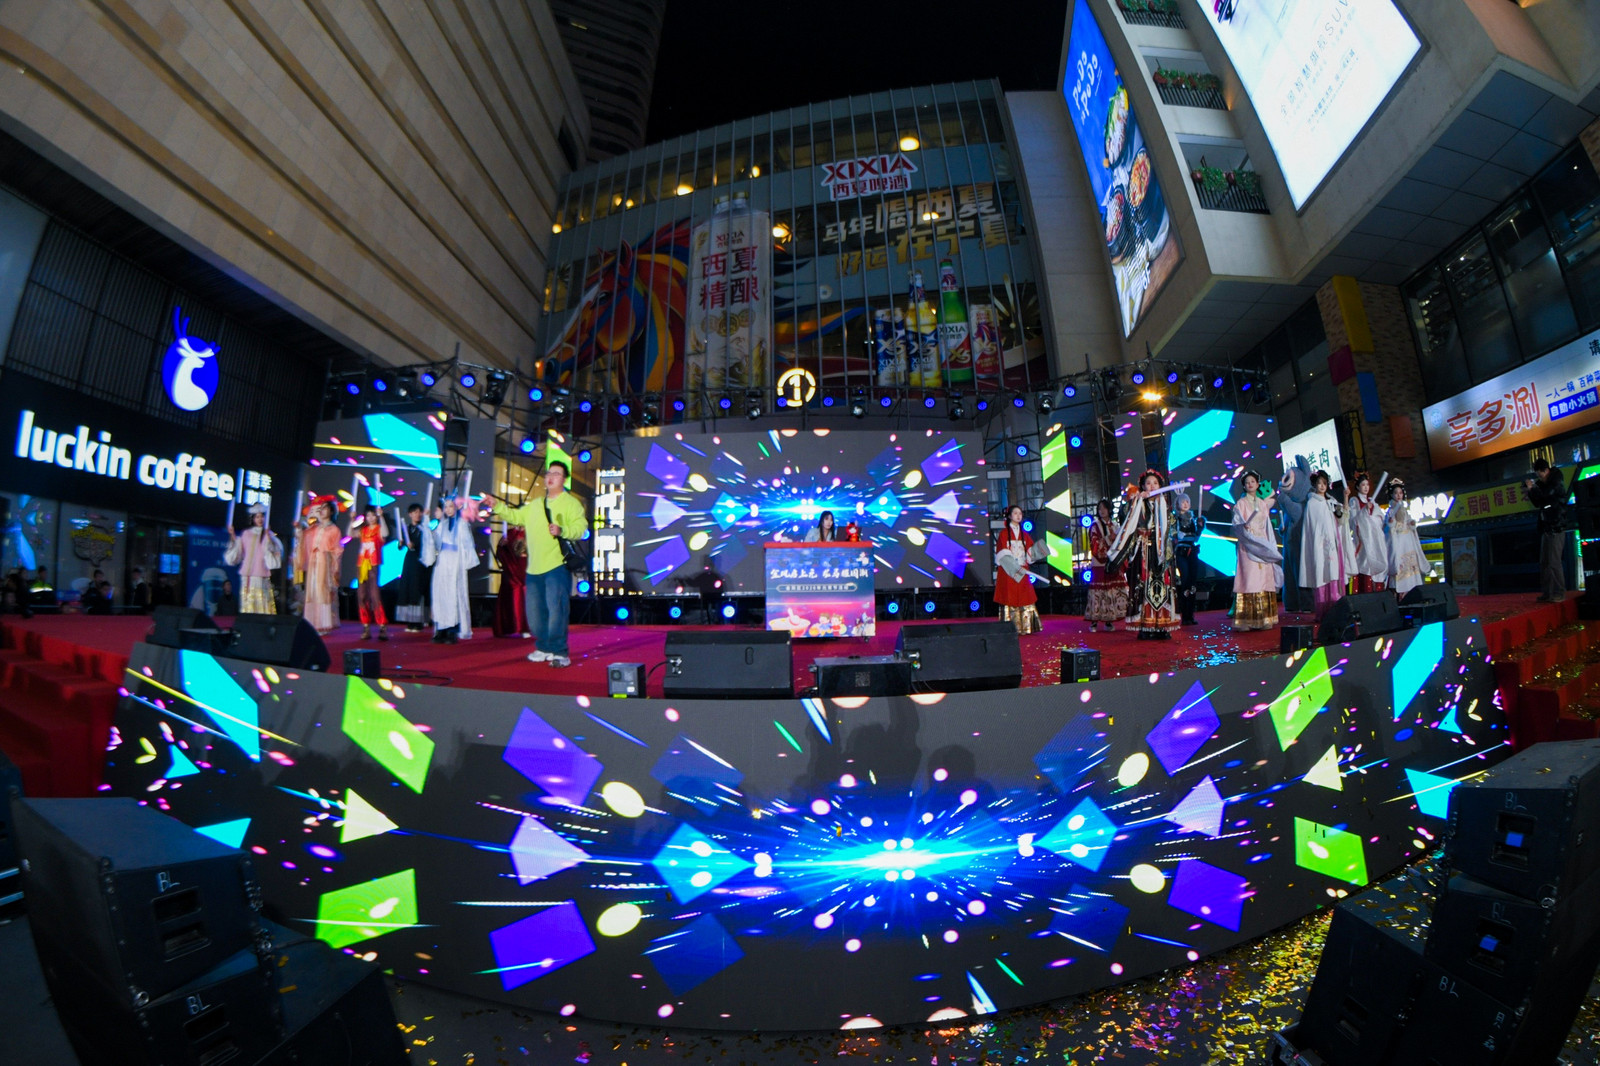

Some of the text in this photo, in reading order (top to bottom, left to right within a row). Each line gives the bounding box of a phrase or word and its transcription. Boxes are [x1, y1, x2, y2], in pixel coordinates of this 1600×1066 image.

[824, 154, 916, 184] XIXIA
[832, 174, 909, 199] 西夏啤酒
[822, 183, 997, 244] 马年喝西夏
[835, 214, 1012, 279] 好运在宁夏
[701, 246, 759, 281] 西夏
[699, 275, 760, 311] 精酿
[1446, 381, 1543, 452] 享多涮
[1549, 391, 1597, 418] 自助小火锅
[14, 410, 235, 502] luckin coffee
[156, 871, 181, 894] BL
[1438, 975, 1460, 998] BL
[186, 993, 212, 1016] BL
